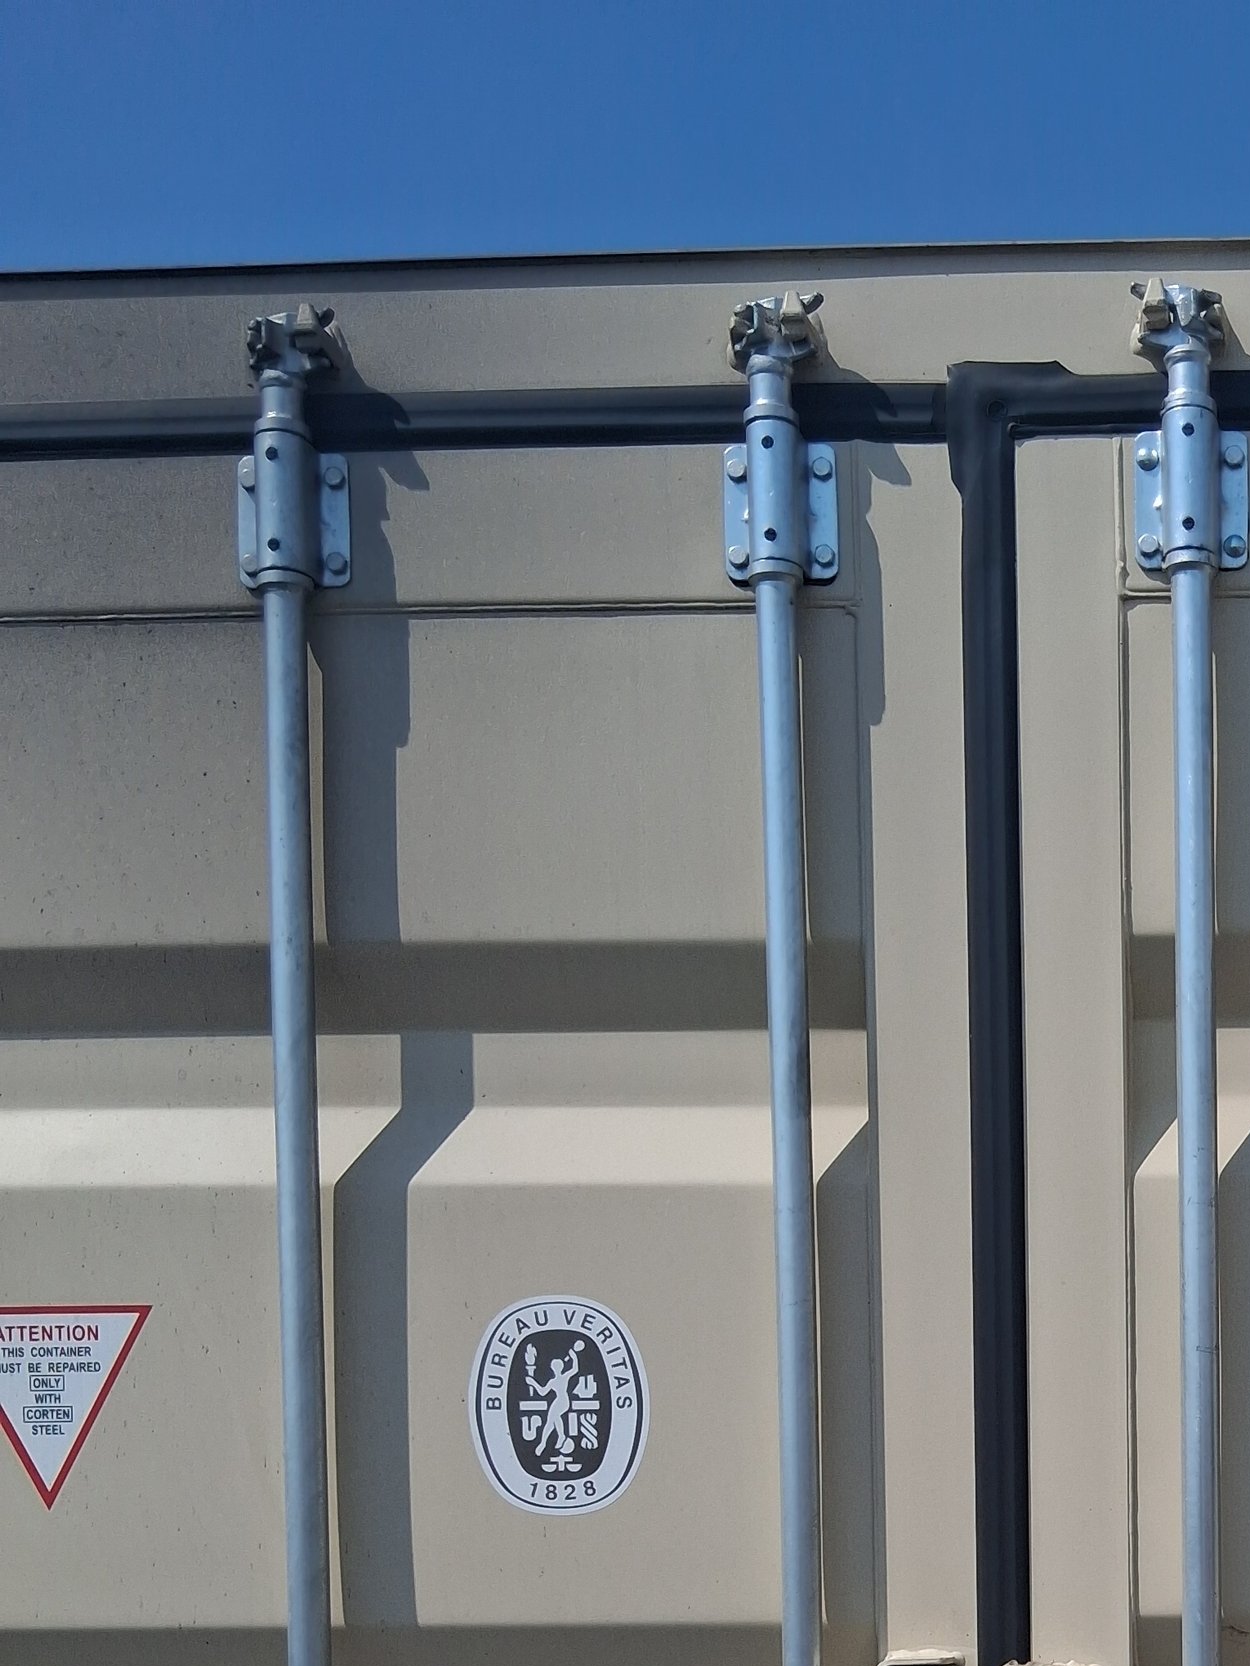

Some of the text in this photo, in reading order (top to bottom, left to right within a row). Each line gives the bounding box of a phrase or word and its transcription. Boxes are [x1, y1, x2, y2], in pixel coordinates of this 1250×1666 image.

[1, 1346, 92, 1358] THIS CONTAINER
[486, 1309, 633, 1411] BUREAU VERITAS
[0, 1361, 101, 1374] UST BE REPAIRED
[33, 1377, 61, 1389] ONLY
[34, 1393, 61, 1404] WITH
[26, 1408, 70, 1420] CORTEN
[31, 1424, 65, 1435] STEEL
[529, 1481, 597, 1500] 1828
